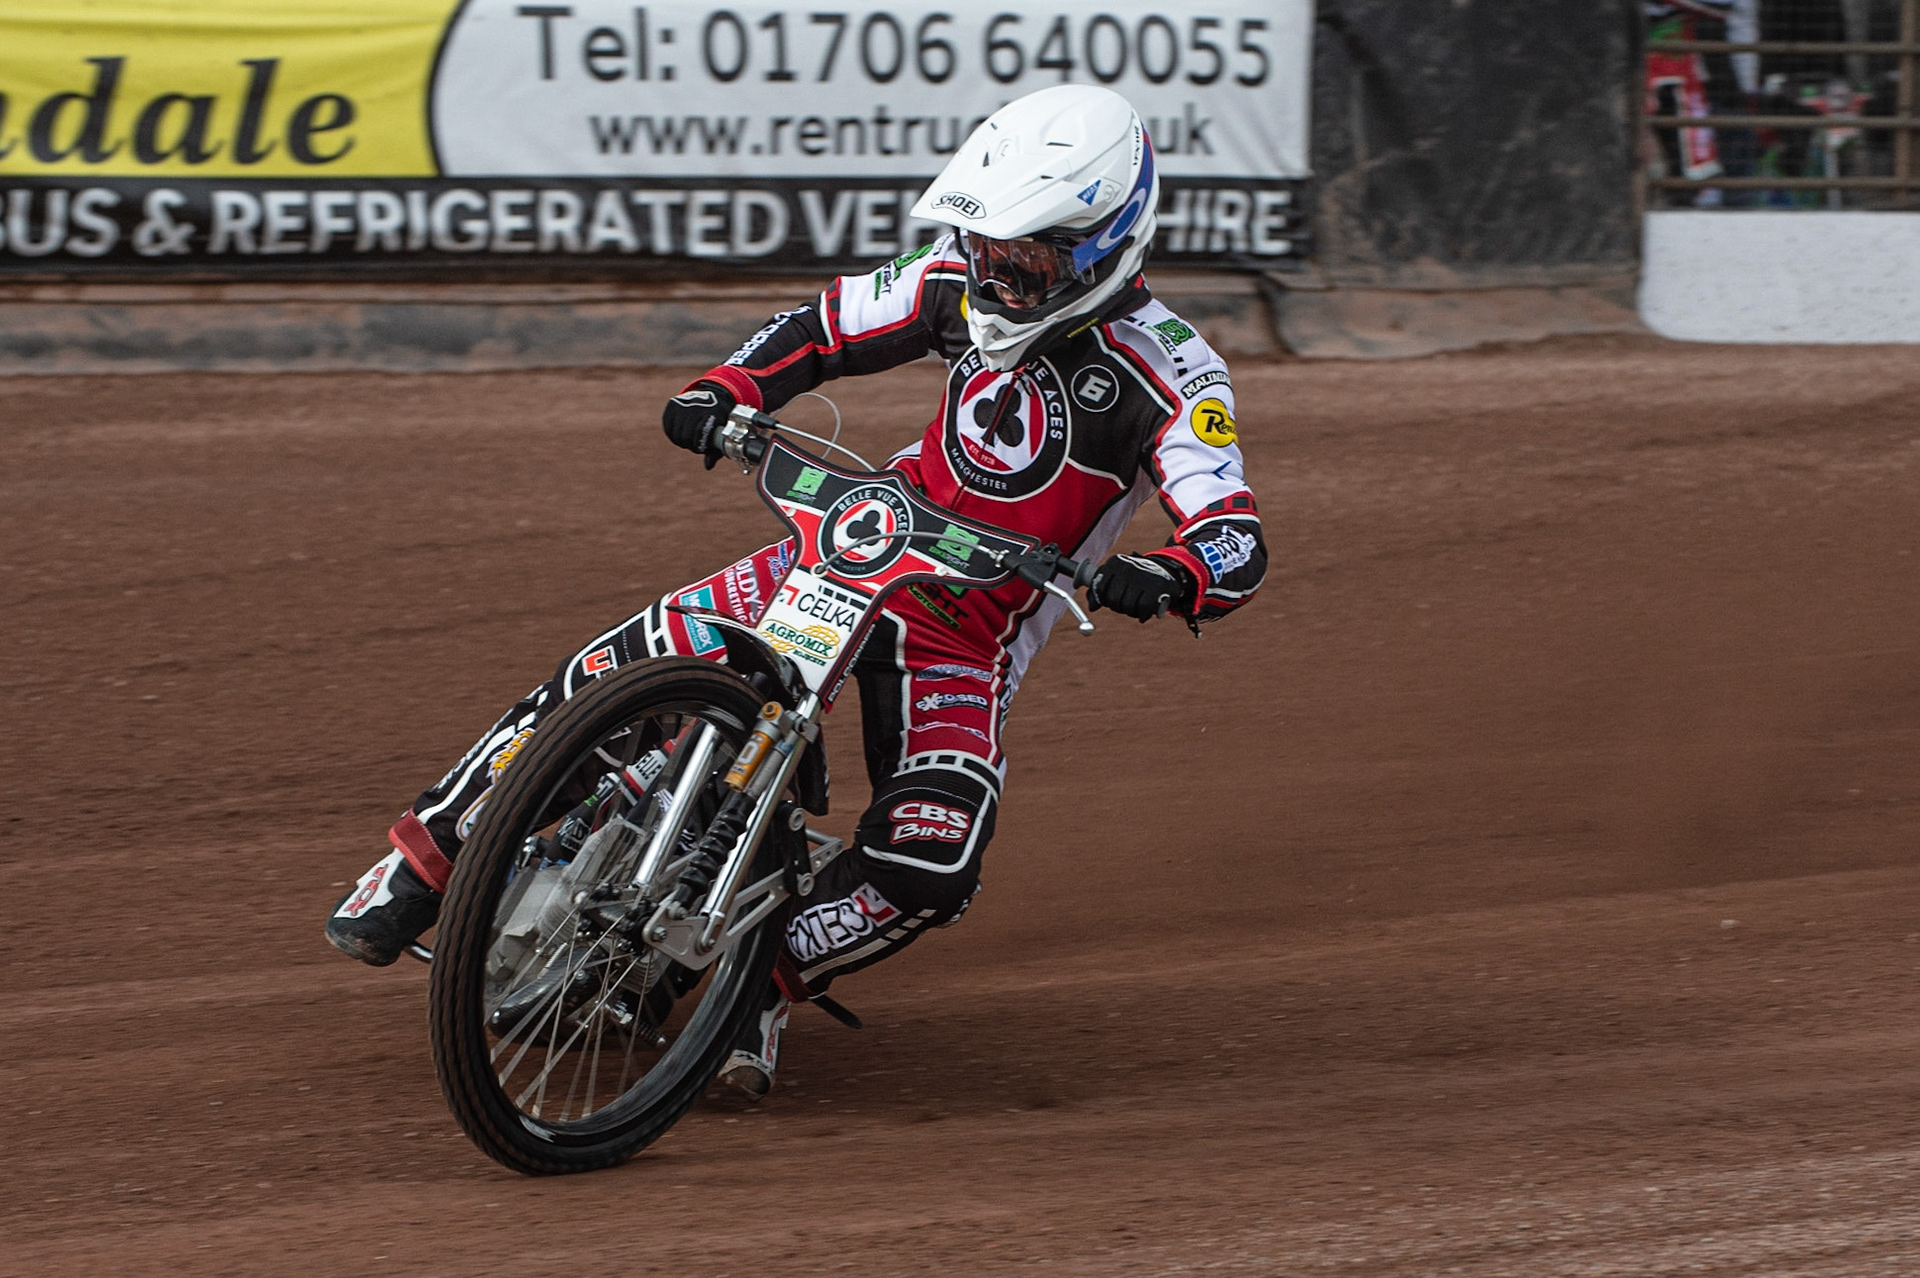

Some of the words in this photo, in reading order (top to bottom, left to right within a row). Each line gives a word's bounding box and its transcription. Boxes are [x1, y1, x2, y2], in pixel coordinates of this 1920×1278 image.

[516, 5, 677, 82] Tel:
[703, 10, 956, 84] 01706
[984, 14, 1272, 88] 640055
[0, 187, 121, 259] US
[131, 189, 195, 257] &
[207, 189, 790, 257] REFRIGERATED
[935, 194, 981, 216] SHOEI
[1043, 388, 1064, 441] ACES
[951, 447, 1008, 491] MANCHESTER
[838, 490, 872, 510] BELLE
[877, 490, 898, 505] VUE
[797, 593, 856, 633] CELKA
[765, 622, 833, 657] AGROMIX
[891, 802, 969, 829] CBS
[892, 823, 963, 841] BINS
